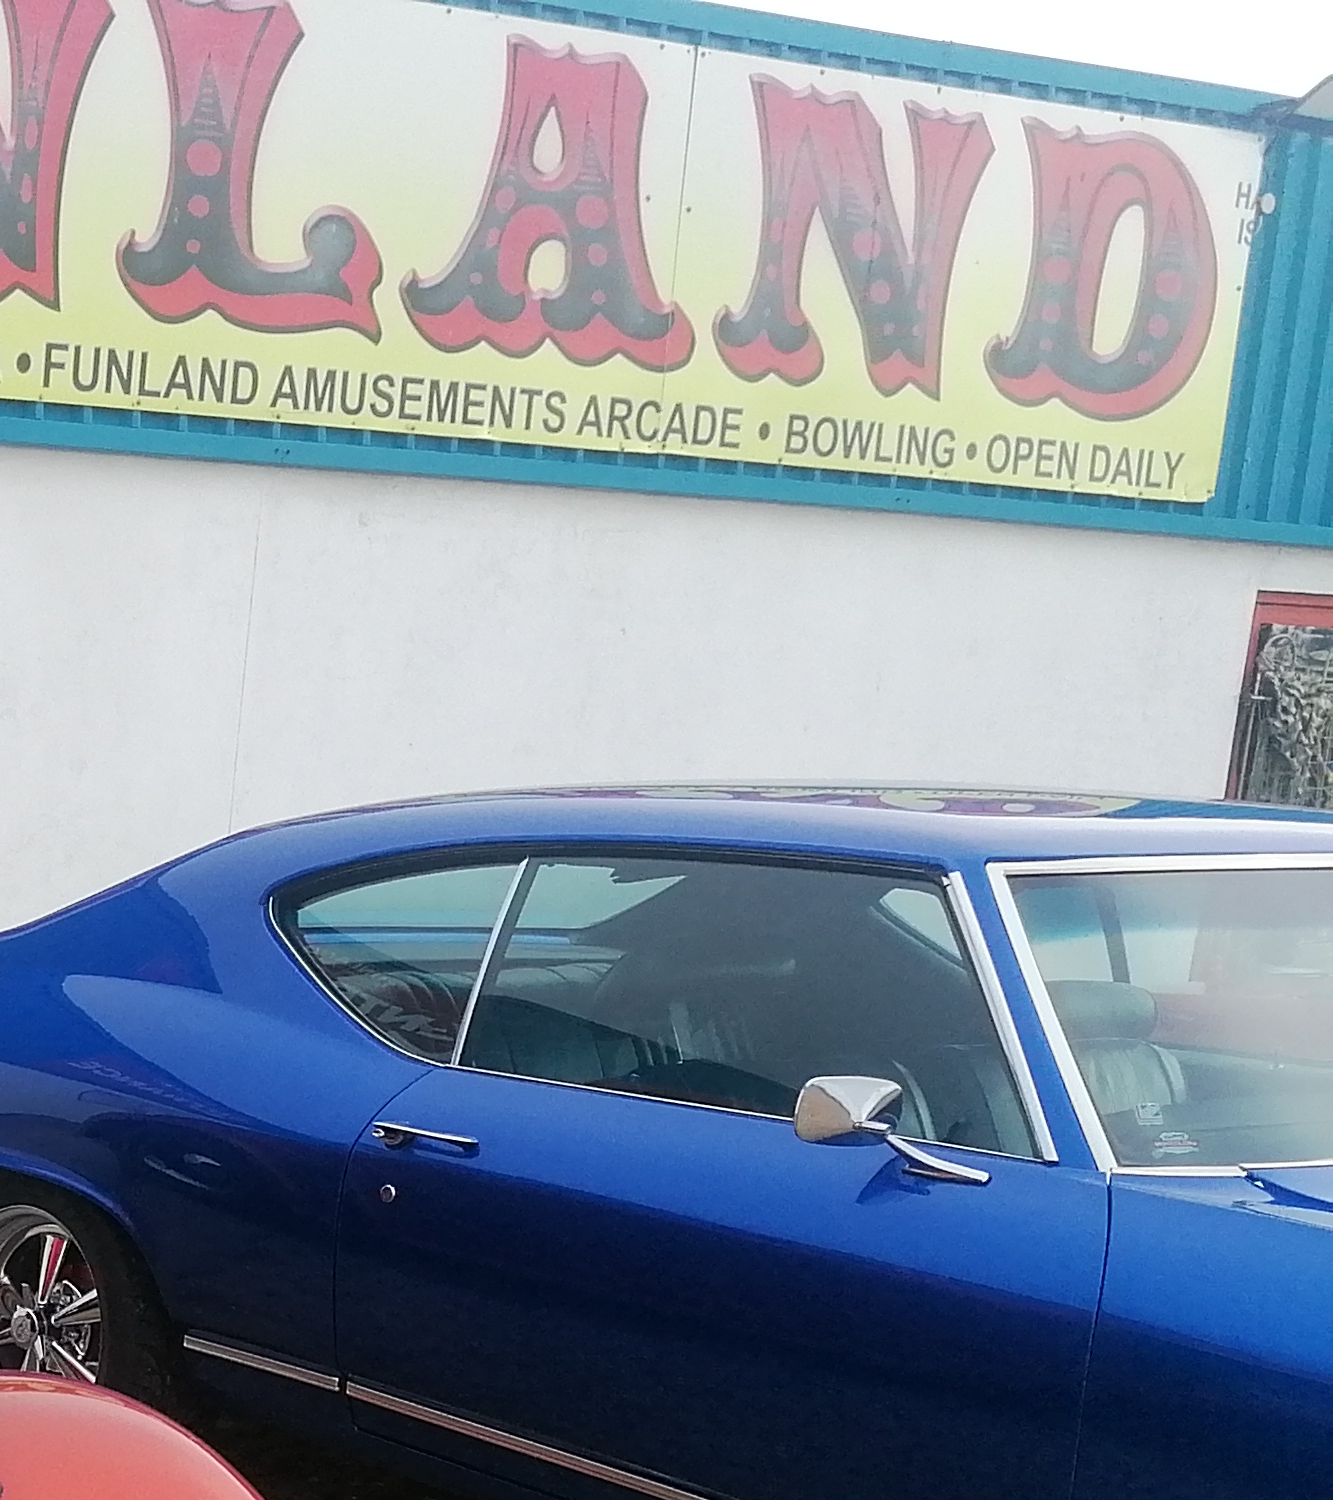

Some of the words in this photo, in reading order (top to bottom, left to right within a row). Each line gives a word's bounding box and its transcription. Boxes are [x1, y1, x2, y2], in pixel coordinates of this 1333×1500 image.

[1236, 182, 1256, 210] H
[41, 342, 259, 406] FUNLAND
[270, 366, 567, 434] AMUSEMENTS
[576, 397, 745, 449] ARCADE
[784, 414, 956, 470] BOWLING
[986, 433, 1081, 481] OPEN
[1087, 444, 1186, 491] DAILY
